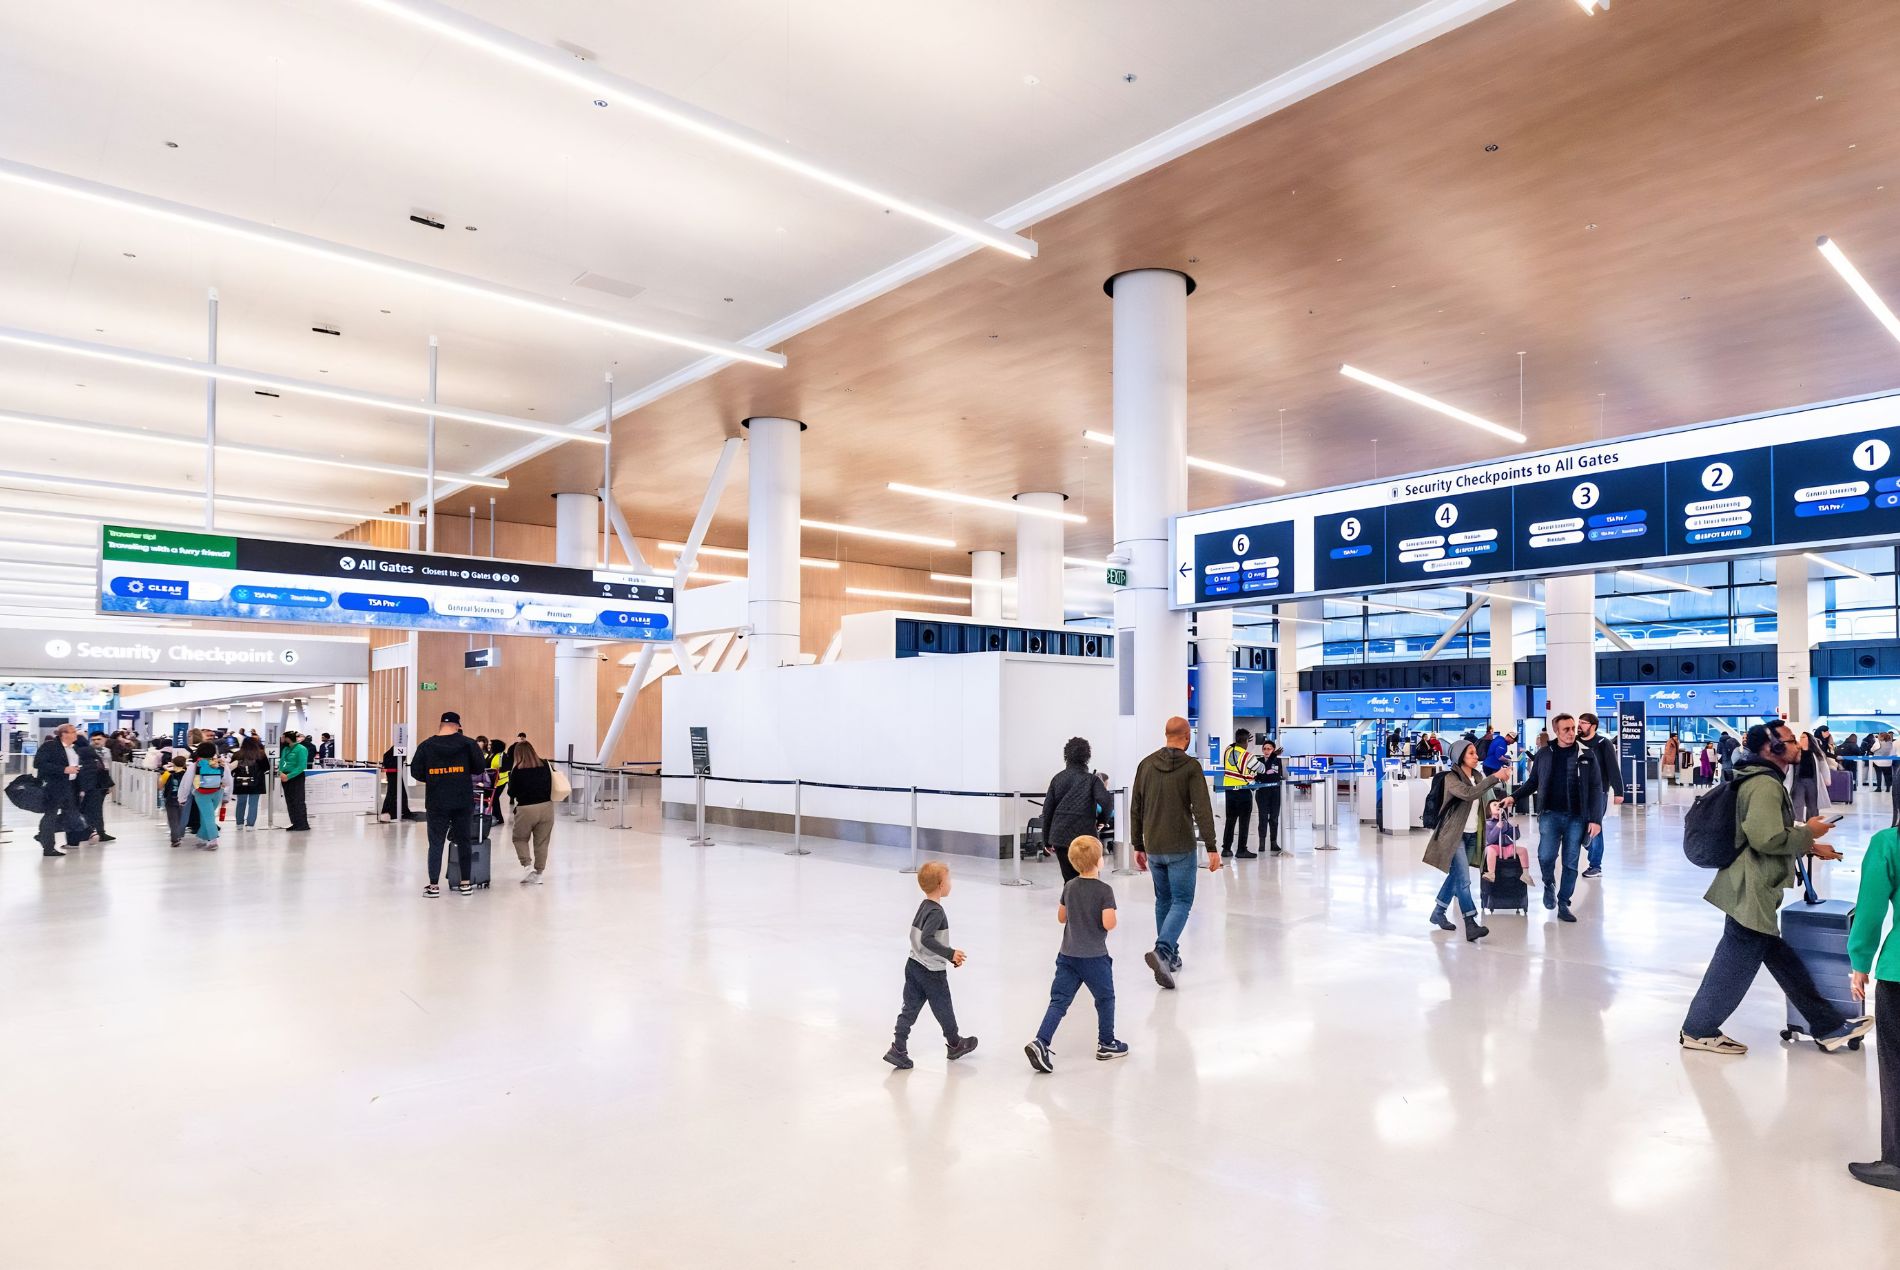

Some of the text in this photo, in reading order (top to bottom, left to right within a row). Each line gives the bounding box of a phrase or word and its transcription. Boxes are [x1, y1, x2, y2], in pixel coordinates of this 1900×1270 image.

[1864, 445, 1874, 466] 1
[1405, 453, 1619, 497] Security Checkpoints to All Gates
[1711, 467, 1723, 487] 2
[1580, 487, 1590, 505] 3
[1440, 507, 1450, 524] 4
[1818, 504, 1830, 512] TSA
[108, 530, 142, 539] Traveler
[1346, 521, 1355, 537] 5
[107, 541, 150, 552] Traveling
[150, 544, 170, 553] with
[179, 547, 200, 556] furry
[200, 548, 231, 558] friend?
[1237, 537, 1245, 552] 6
[359, 559, 376, 571] All
[379, 561, 414, 574] Gates
[421, 567, 448, 576] Closest
[471, 571, 491, 580] Gates
[147, 584, 183, 593] CLEAR
[368, 598, 395, 608] TSA Pre
[447, 603, 472, 612] General
[77, 642, 294, 665] Security Checkpoint 6
[1658, 702, 1689, 710] Drop Bag
